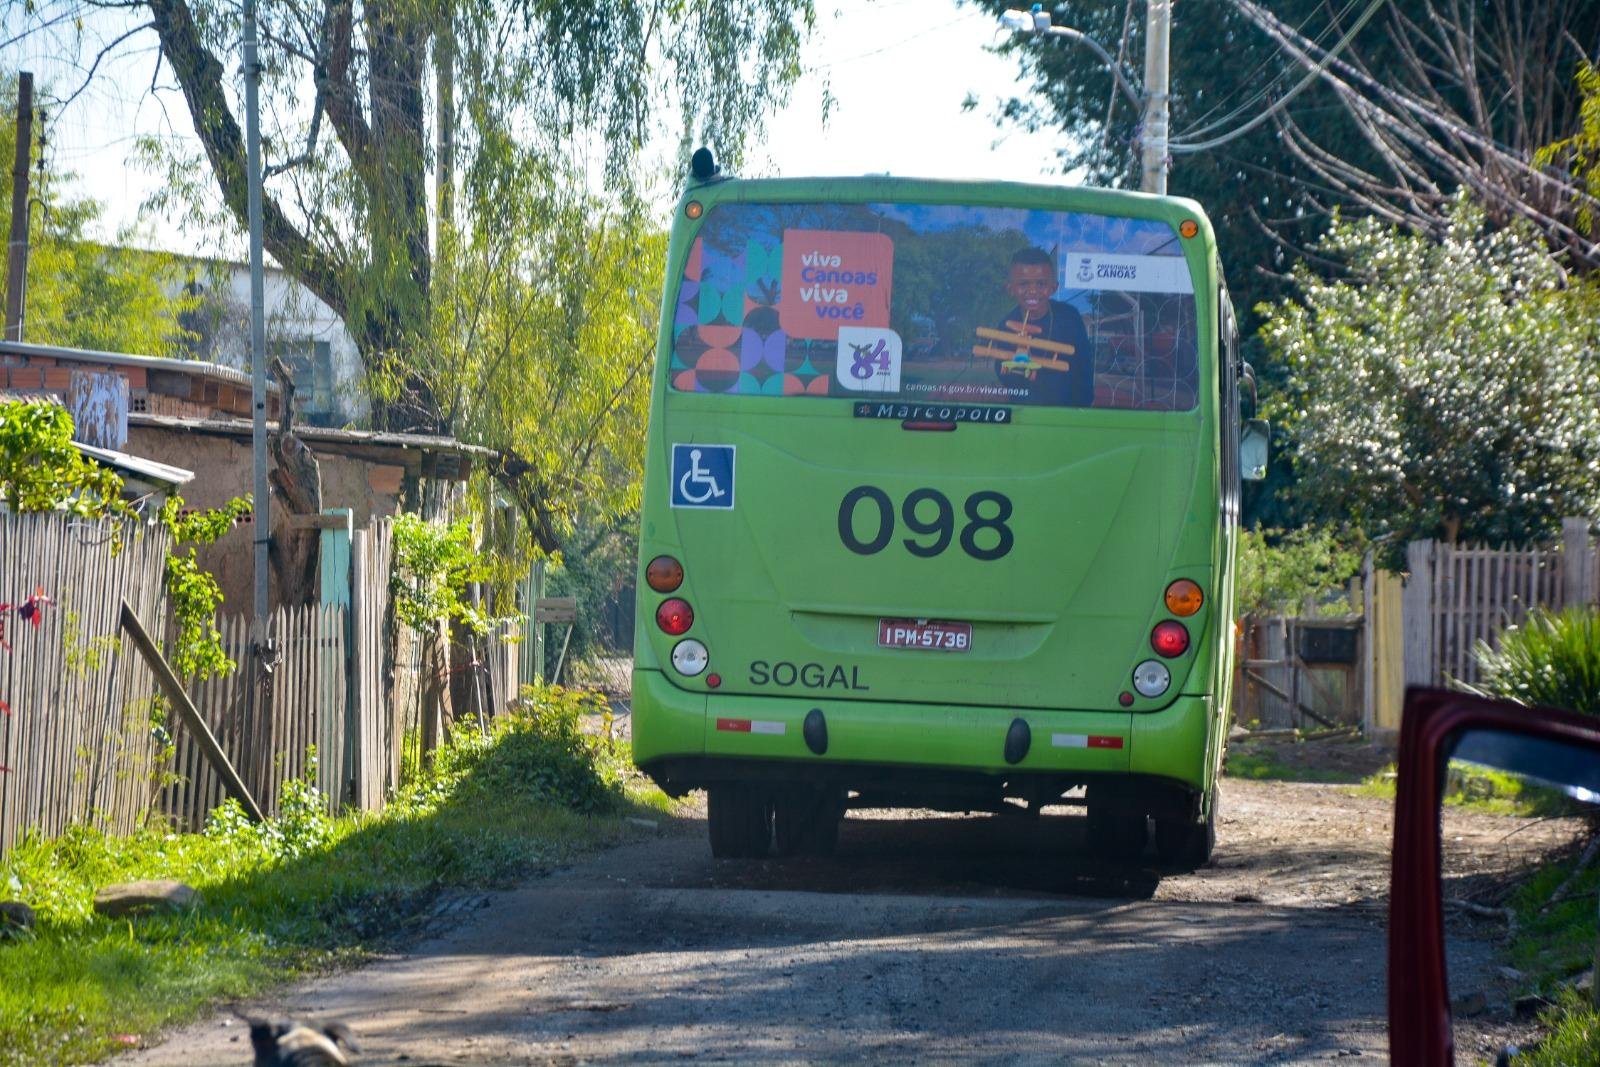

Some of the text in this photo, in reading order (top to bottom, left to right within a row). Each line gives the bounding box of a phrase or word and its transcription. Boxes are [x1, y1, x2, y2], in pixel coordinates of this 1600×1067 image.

[801, 251, 841, 268] viva
[801, 267, 878, 286] Canoas
[1097, 268, 1137, 279] CANOAS
[799, 283, 848, 304] viva
[815, 302, 865, 321] você
[850, 338, 891, 380] 84
[905, 383, 1029, 397] canoas.rs.gov.br/vivacanoas
[877, 404, 1007, 422] Marcopolo
[838, 485, 1014, 561] 098
[749, 660, 870, 690] SOGAL
